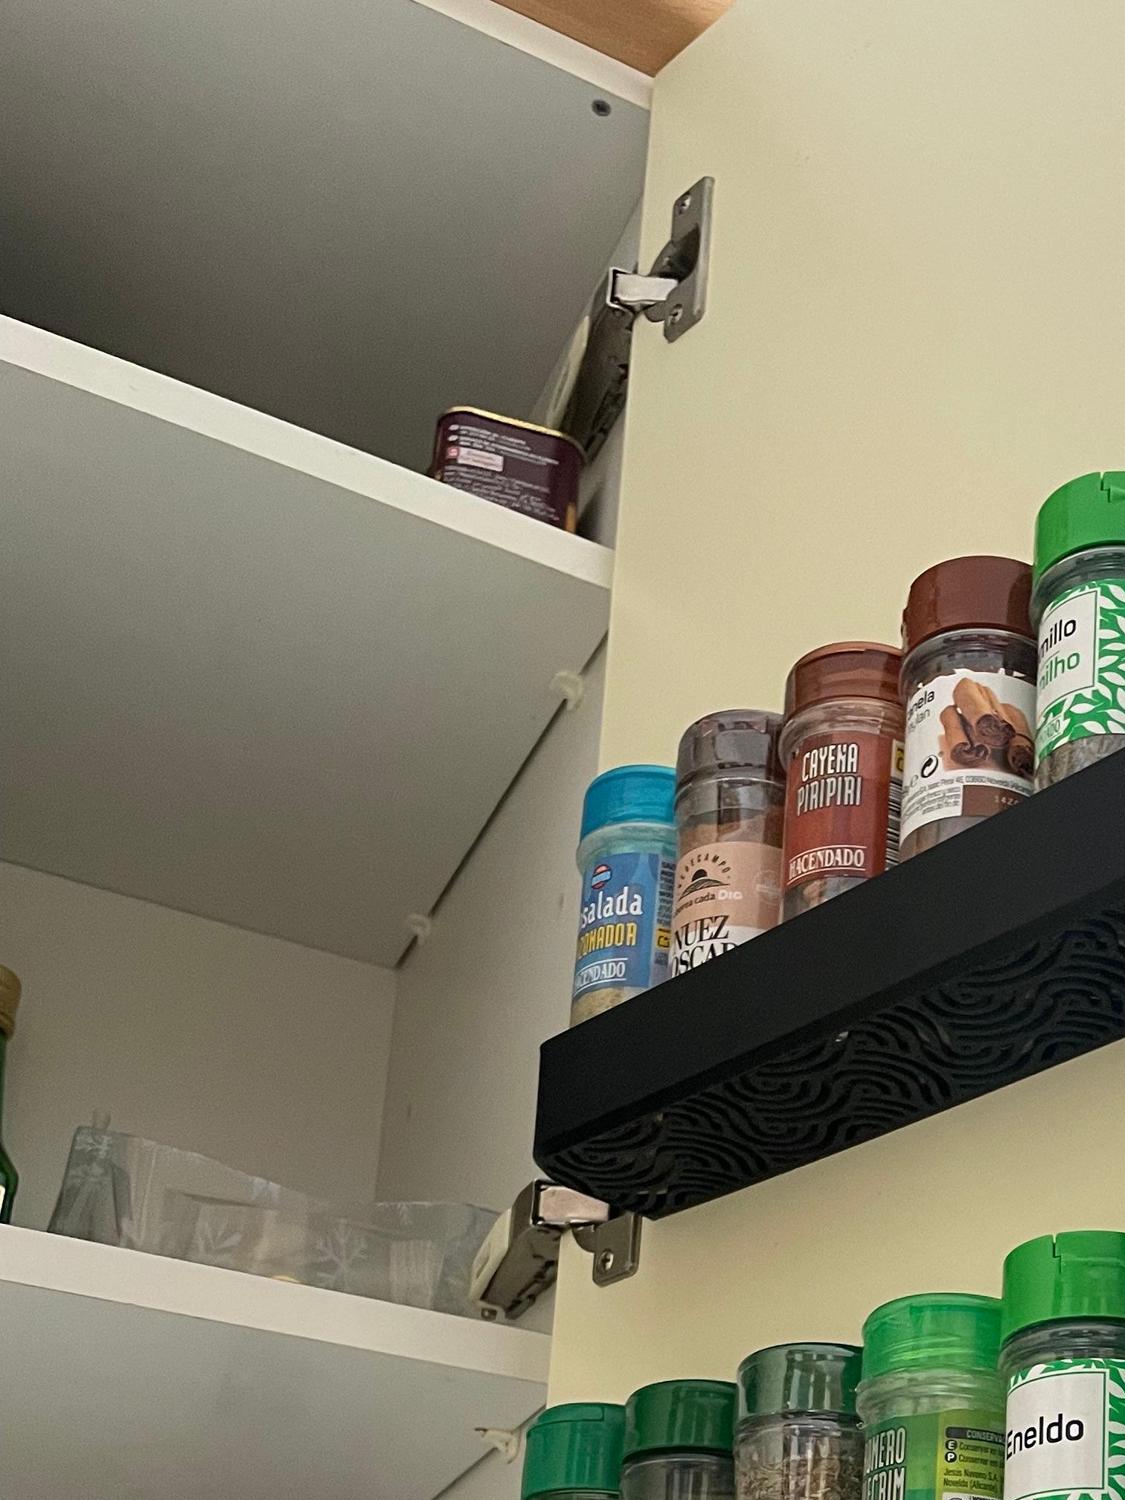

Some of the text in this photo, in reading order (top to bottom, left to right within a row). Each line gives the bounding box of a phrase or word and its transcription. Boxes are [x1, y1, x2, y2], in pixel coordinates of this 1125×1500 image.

[801, 743, 859, 784] CAYENA
[797, 776, 861, 816] PIRIPIRI
[1006, 1413, 1084, 1460] Eneldo
